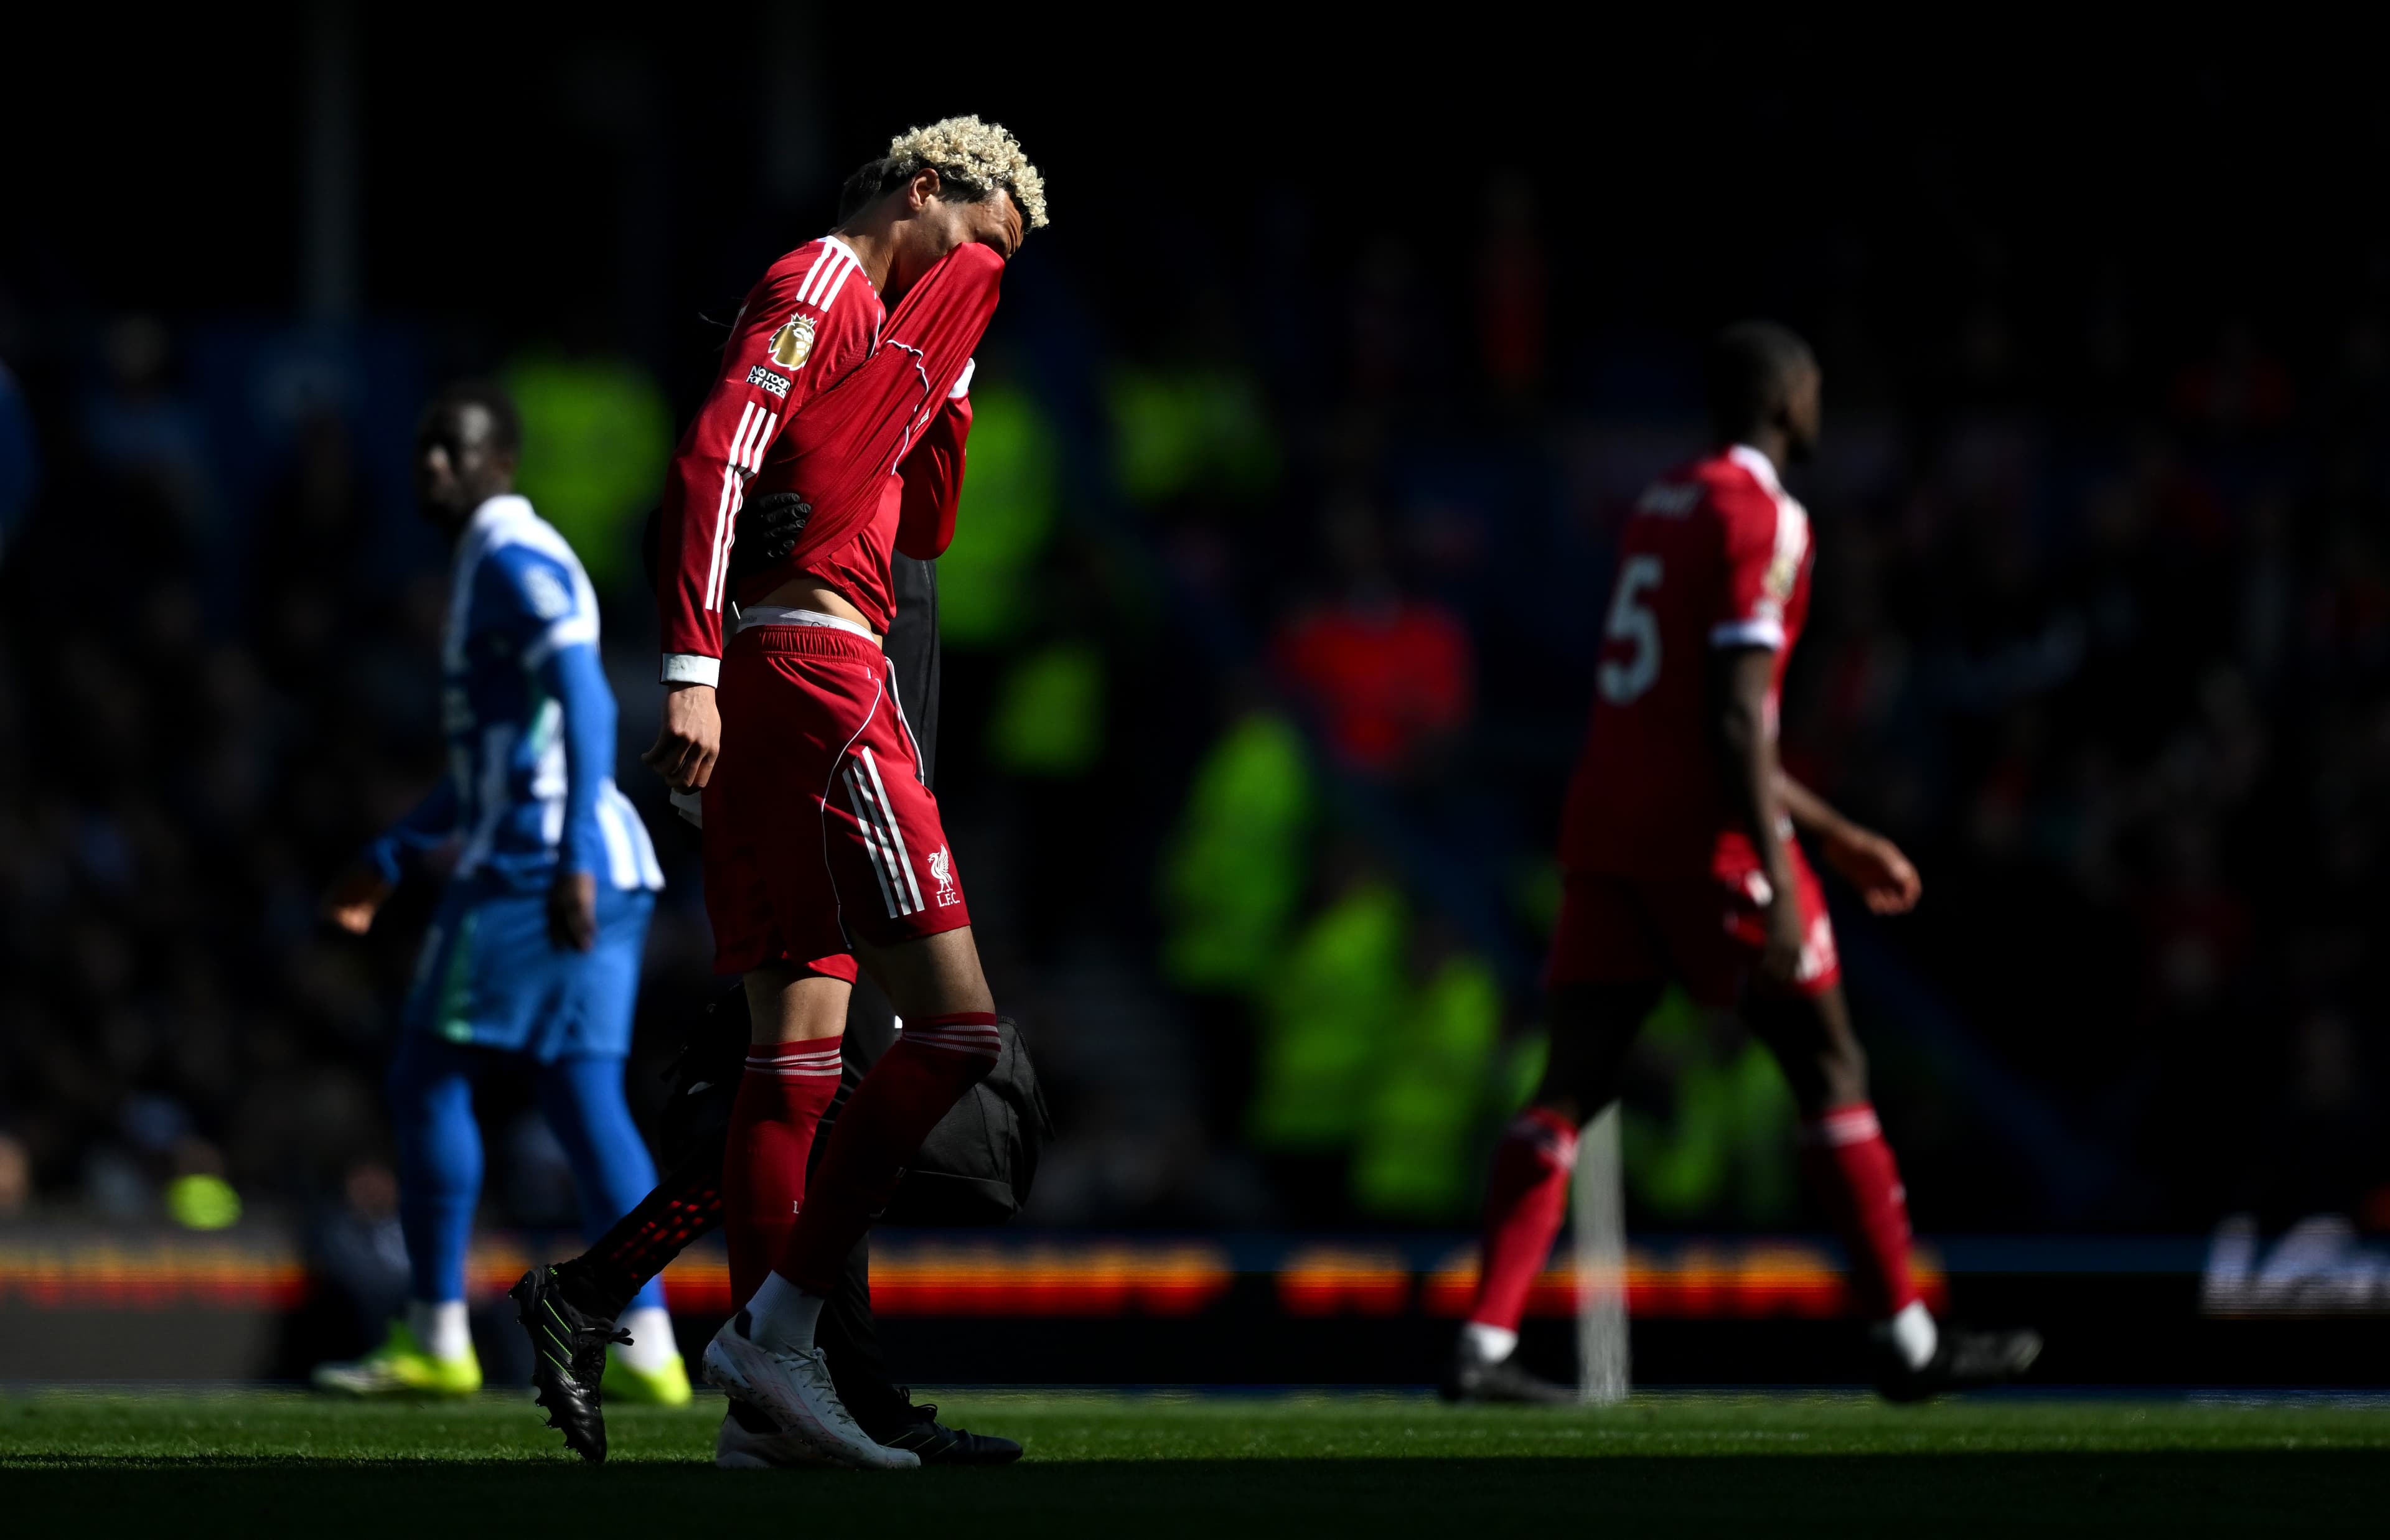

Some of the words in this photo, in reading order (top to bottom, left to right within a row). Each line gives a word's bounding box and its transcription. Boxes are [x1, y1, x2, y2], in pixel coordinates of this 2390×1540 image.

[749, 365, 766, 378] No
[1595, 554, 1664, 706] 5
[936, 892, 960, 907] L.F.C.
